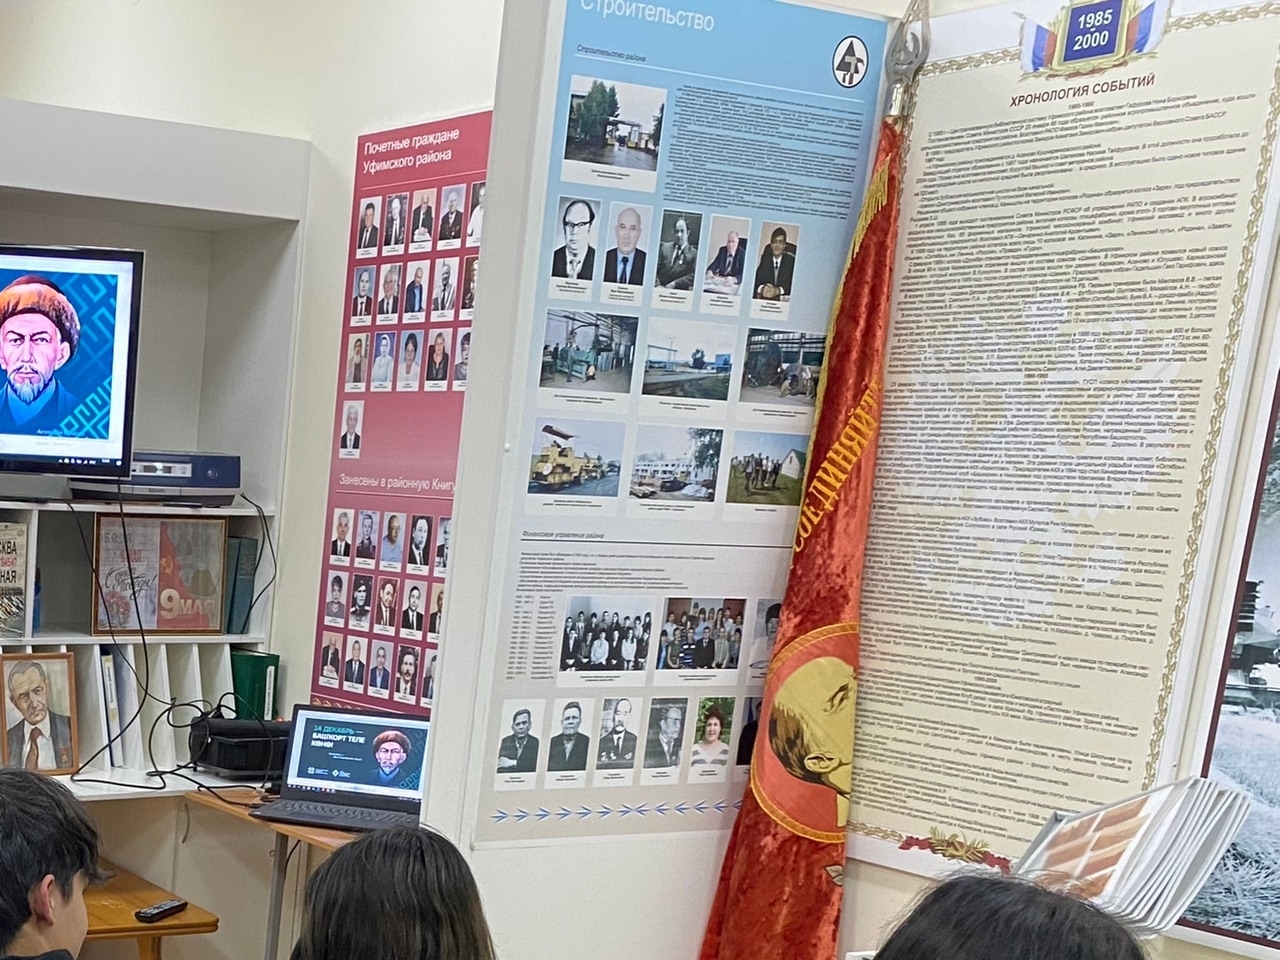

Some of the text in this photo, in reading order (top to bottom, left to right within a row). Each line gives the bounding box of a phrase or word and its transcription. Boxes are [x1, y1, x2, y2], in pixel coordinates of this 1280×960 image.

[580, 0, 715, 32] Строительство
[1077, 9, 1113, 29] 1985
[1072, 30, 1109, 51] 2000
[576, 44, 646, 63] Строительство района
[1009, 72, 1156, 107] ХРОНОЛОГИЯ СОБЫТИЙ
[364, 129, 460, 156] Почетные граждане
[363, 149, 452, 175] Уфимского района
[339, 473, 456, 494] Занесены в районную Книгу
[160, 588, 180, 620] 9
[322, 726, 355, 735] ДЕКАБРЬ
[348, 735, 365, 744] ТЕЛЕ
